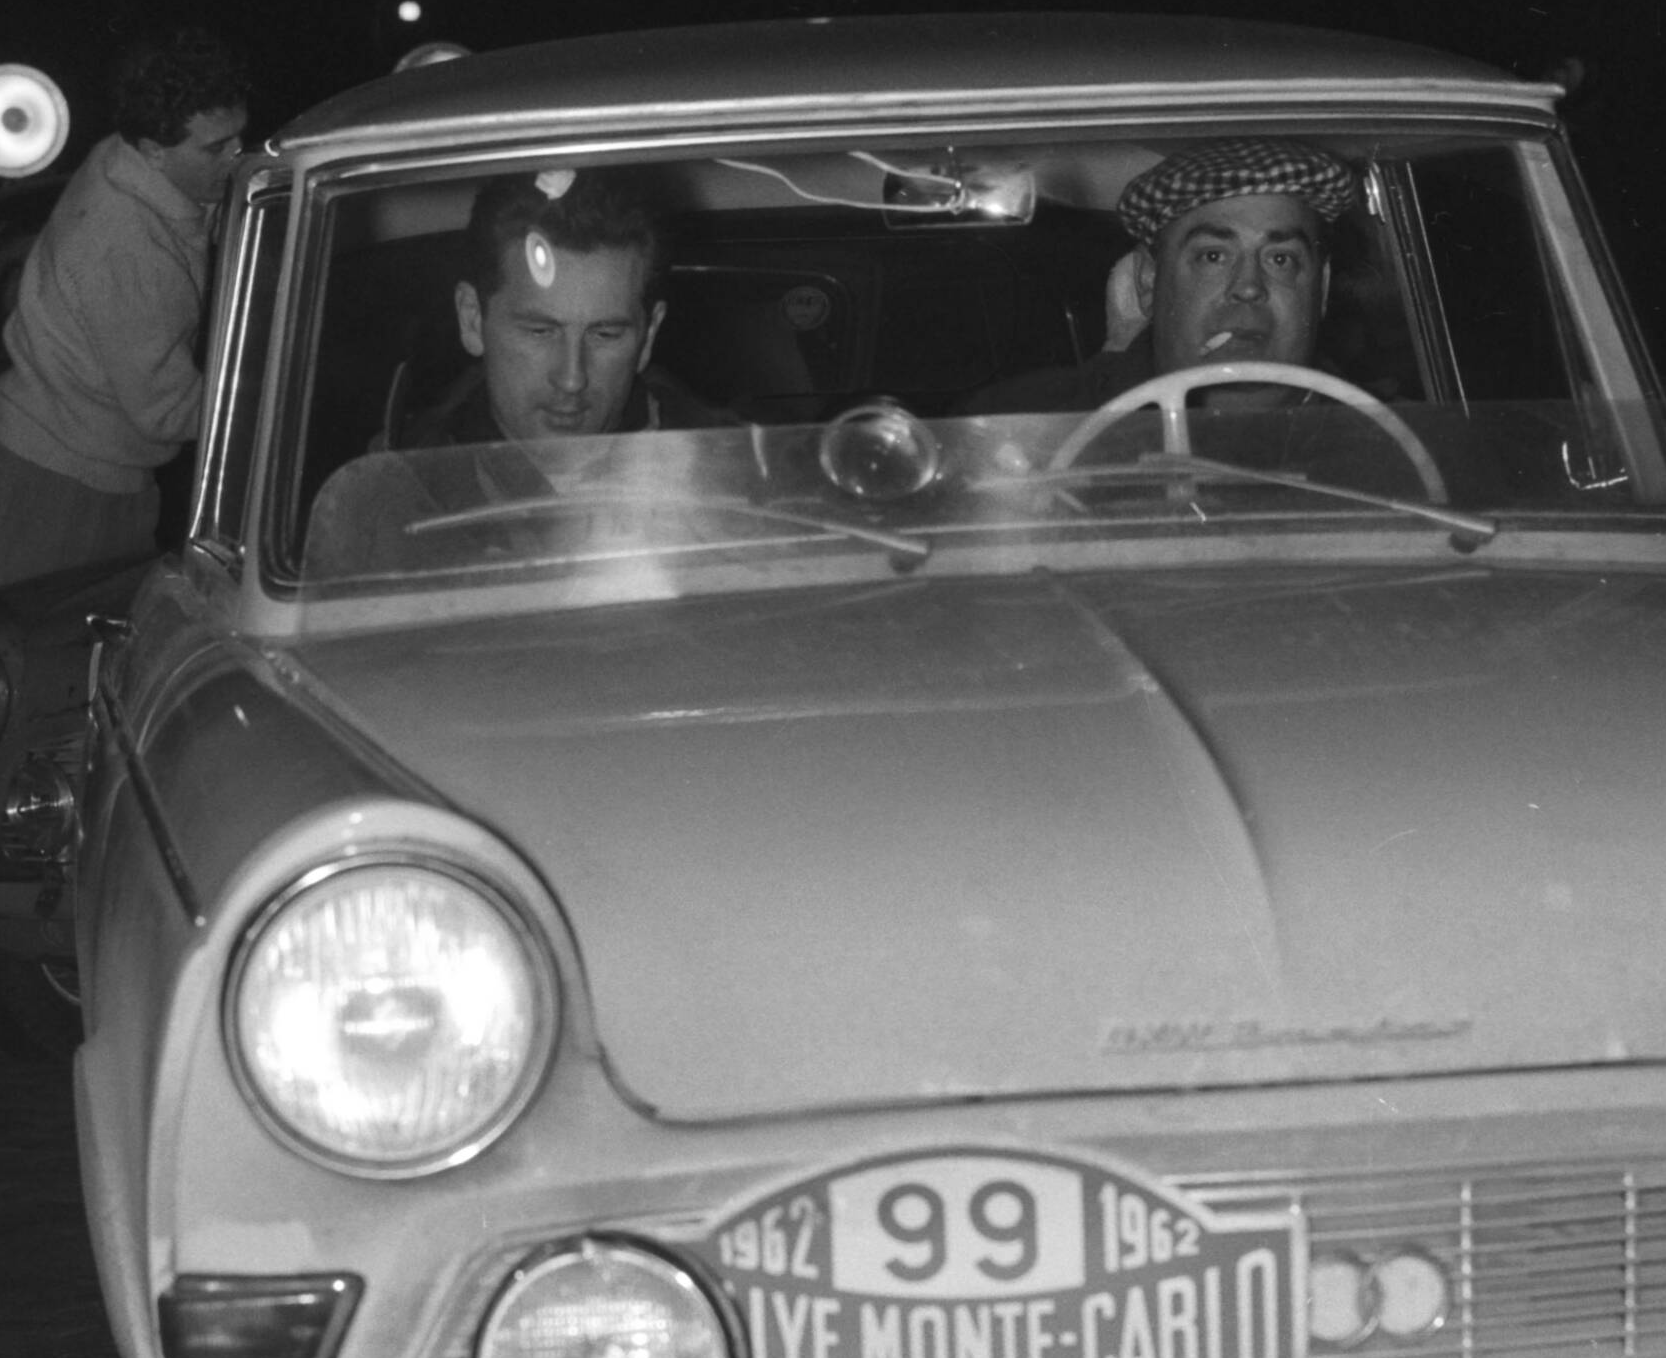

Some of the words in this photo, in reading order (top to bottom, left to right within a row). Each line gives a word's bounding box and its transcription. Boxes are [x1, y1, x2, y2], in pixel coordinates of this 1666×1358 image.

[719, 1195, 821, 1277] 1962
[876, 1179, 1039, 1282] 99
[1099, 1183, 1201, 1272] 1962
